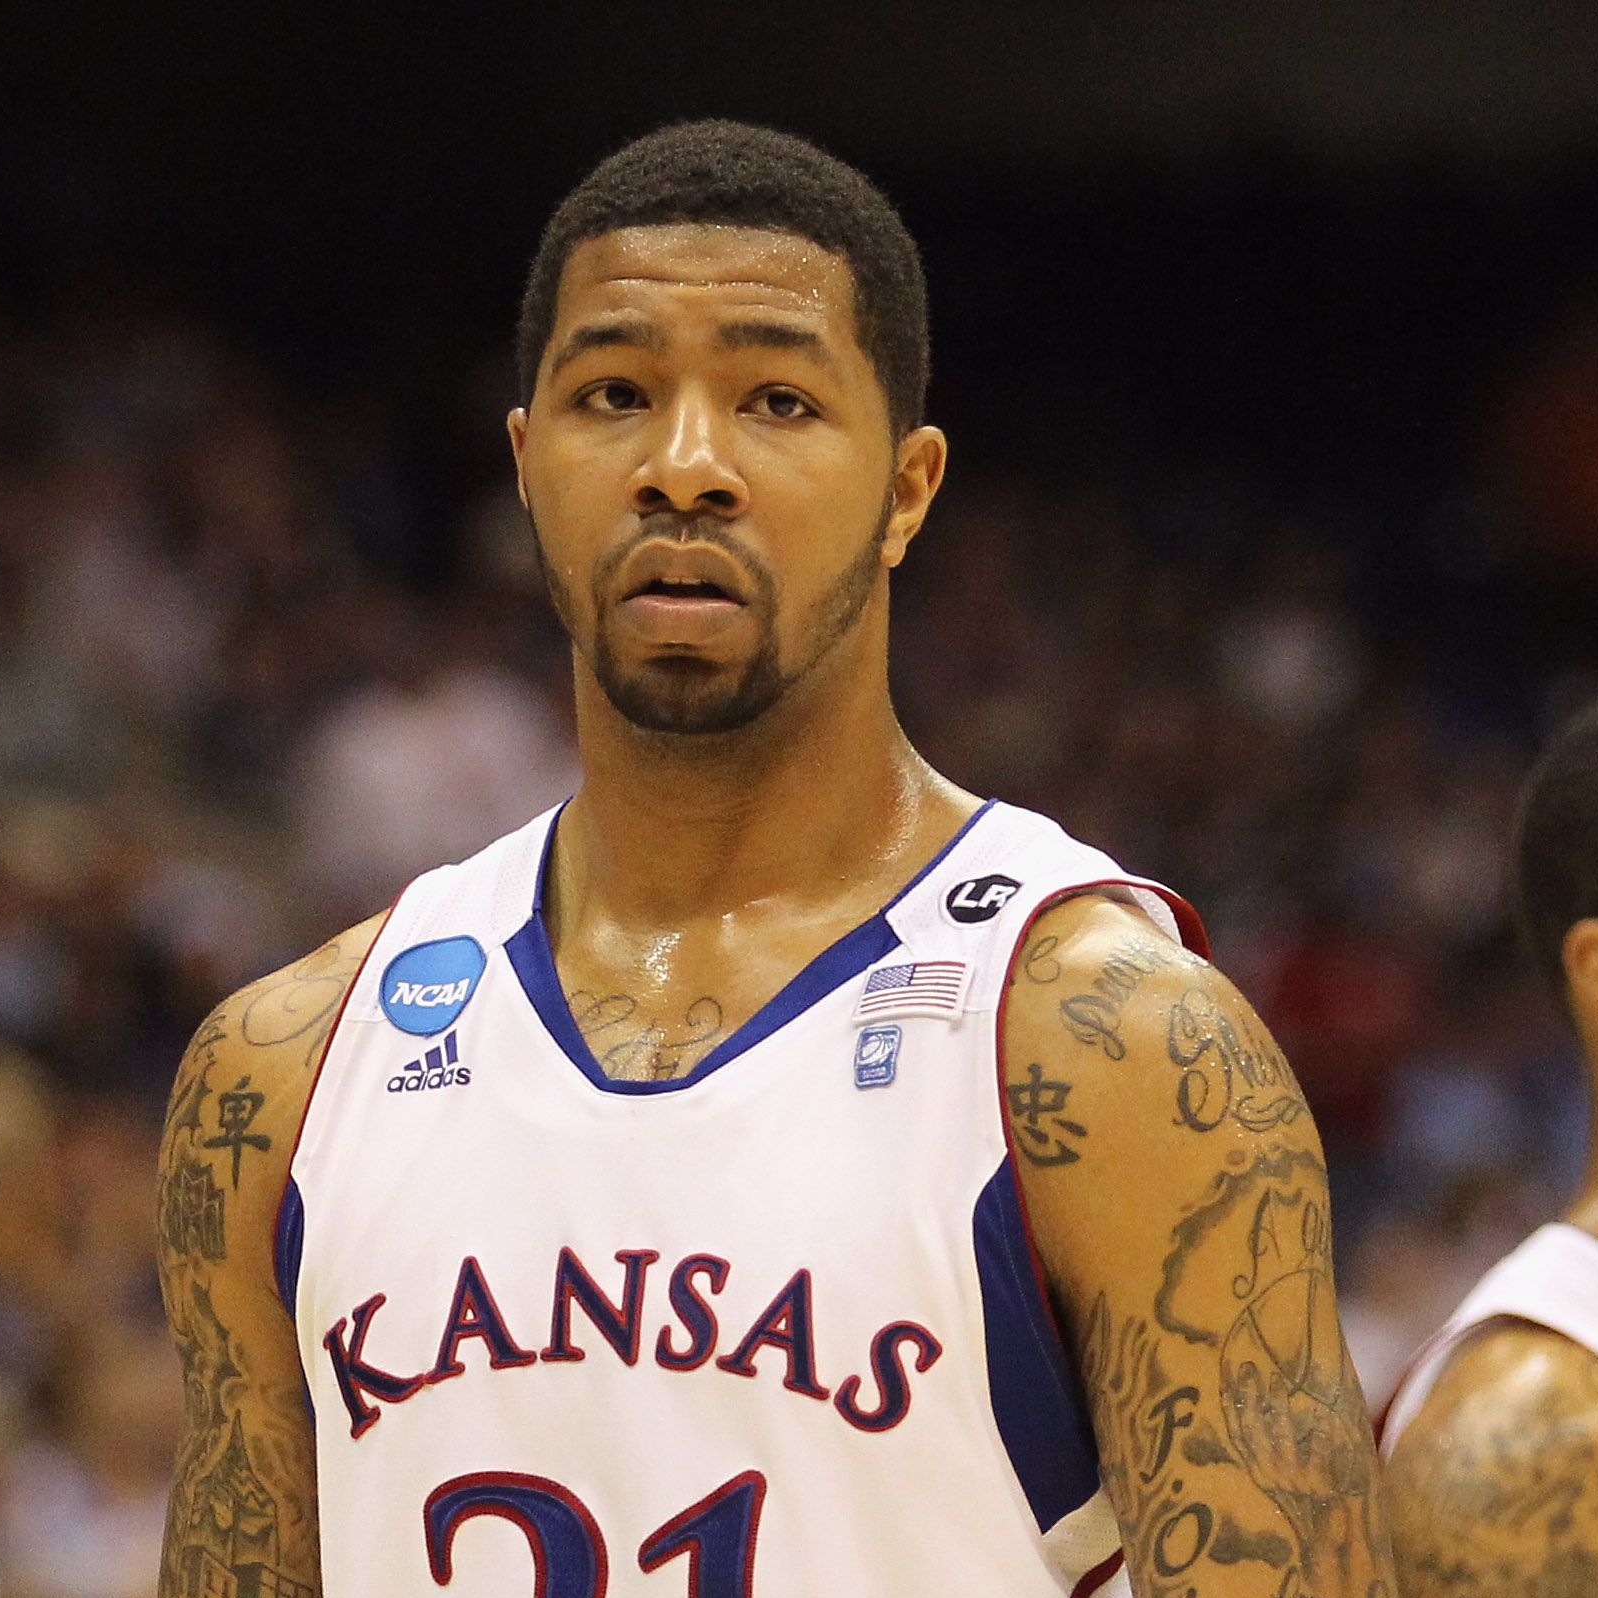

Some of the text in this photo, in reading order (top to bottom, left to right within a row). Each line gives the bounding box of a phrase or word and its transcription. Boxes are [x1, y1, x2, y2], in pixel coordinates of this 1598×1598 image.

[389, 977, 471, 1008] NCAA
[386, 1066, 472, 1093] adidas
[322, 1245, 943, 1439] KANSAS
